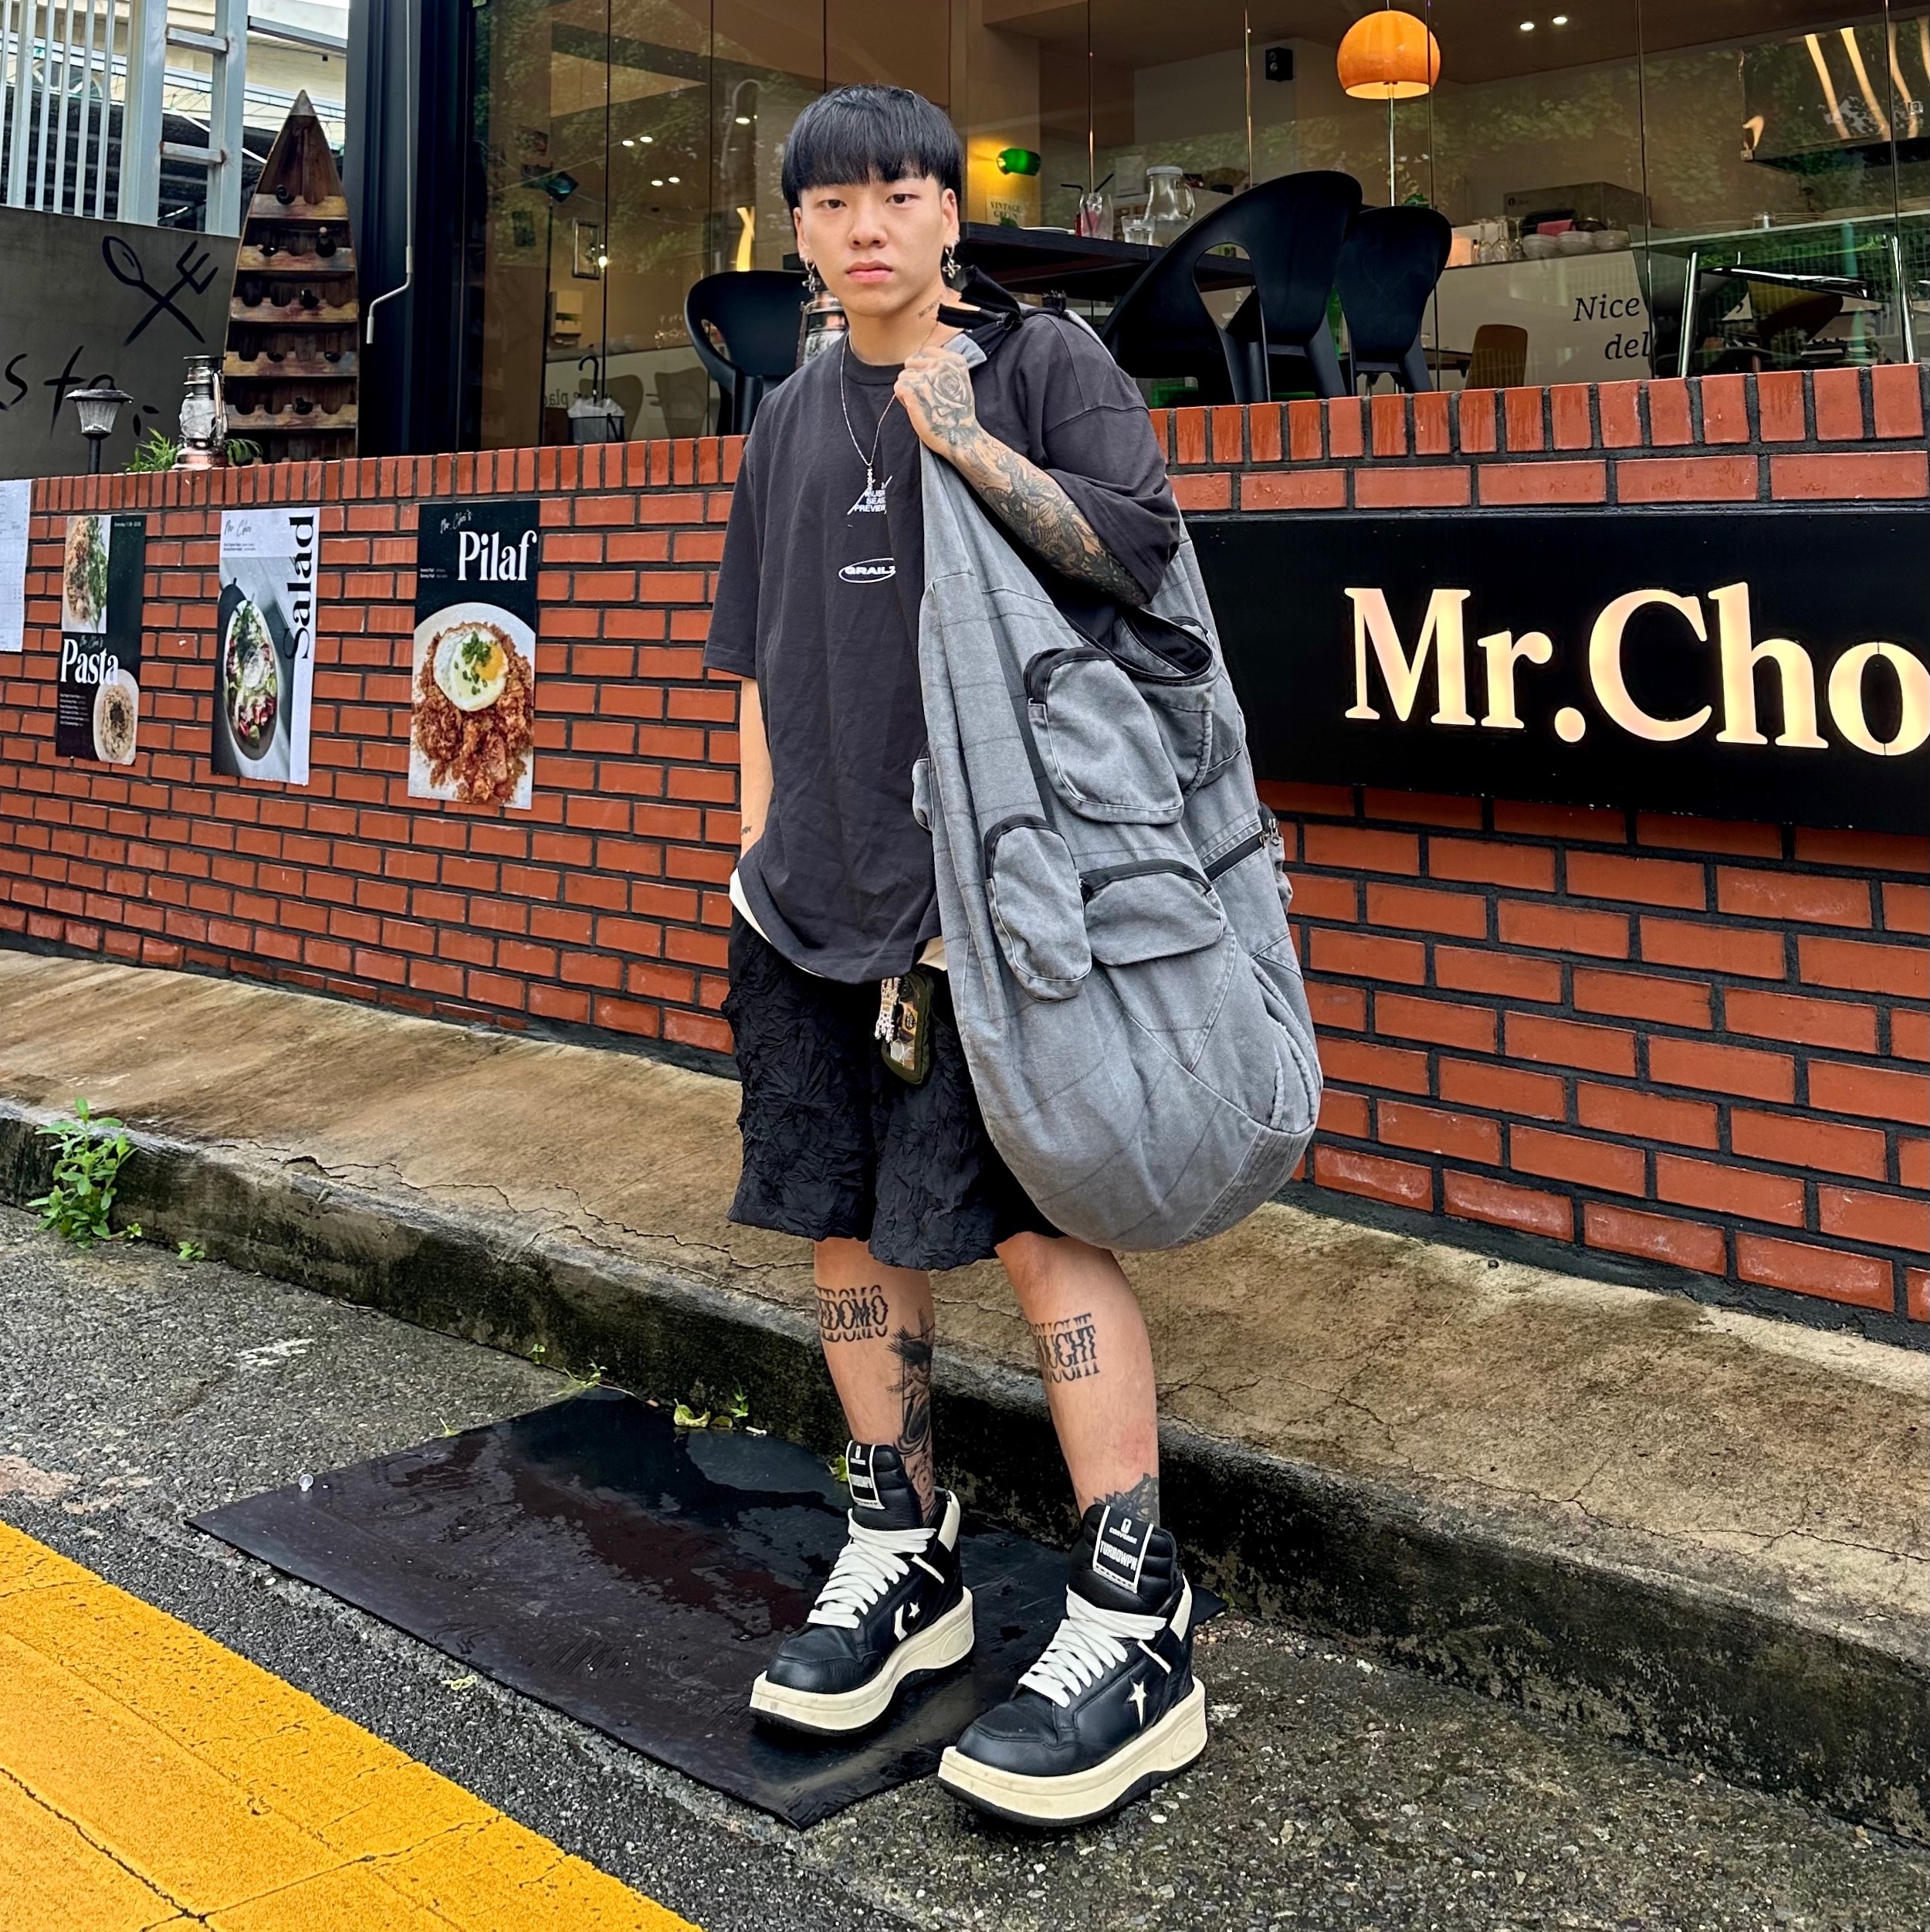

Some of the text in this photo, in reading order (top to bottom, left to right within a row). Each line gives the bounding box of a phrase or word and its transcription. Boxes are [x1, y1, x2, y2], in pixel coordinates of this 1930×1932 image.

[1573, 293, 1640, 322] Nice
[457, 530, 537, 581] Pilaf
[283, 515, 314, 659] Salad
[60, 639, 119, 686] Pasta
